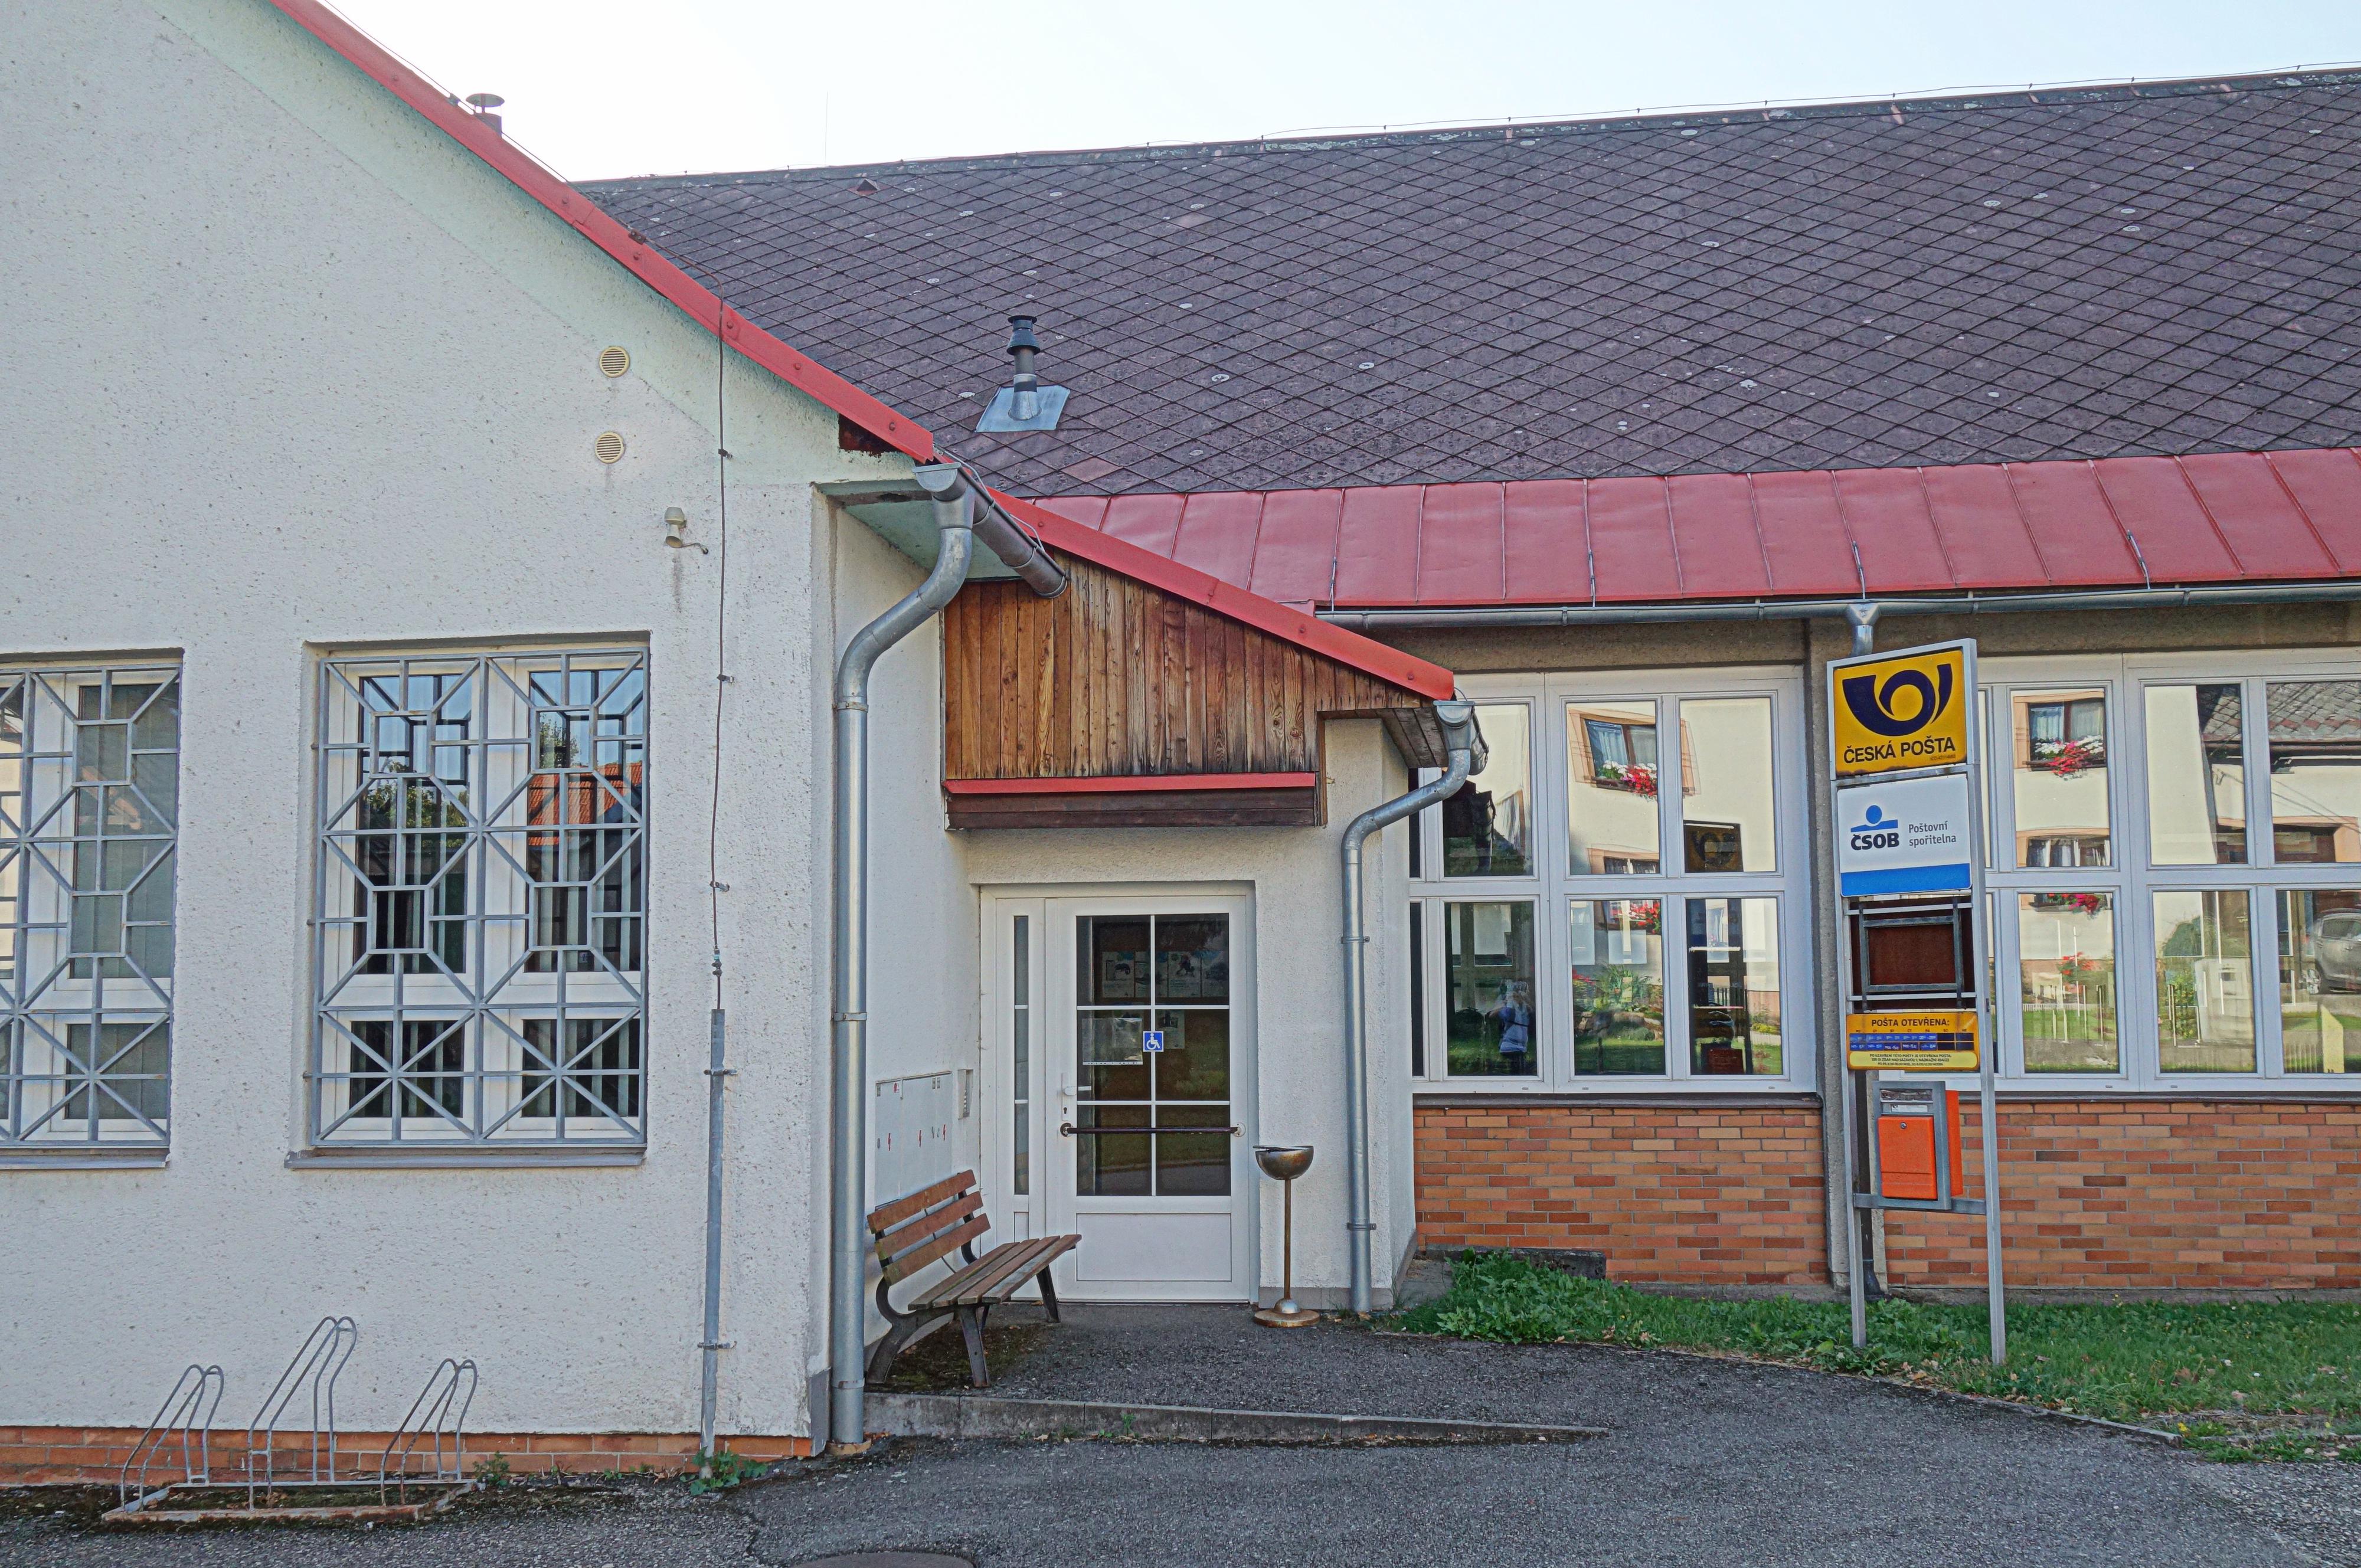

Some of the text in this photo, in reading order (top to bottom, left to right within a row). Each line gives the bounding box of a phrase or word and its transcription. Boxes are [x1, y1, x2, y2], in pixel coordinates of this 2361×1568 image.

[1843, 735, 1955, 764] ČESKÁ POŠTA
[1908, 820, 1948, 833] Poštovní
[1850, 832, 1899, 851] ČSOB
[1909, 834, 1957, 848] spořitelna
[1872, 1017, 1950, 1026] POŠTA OTEVŘENA:
